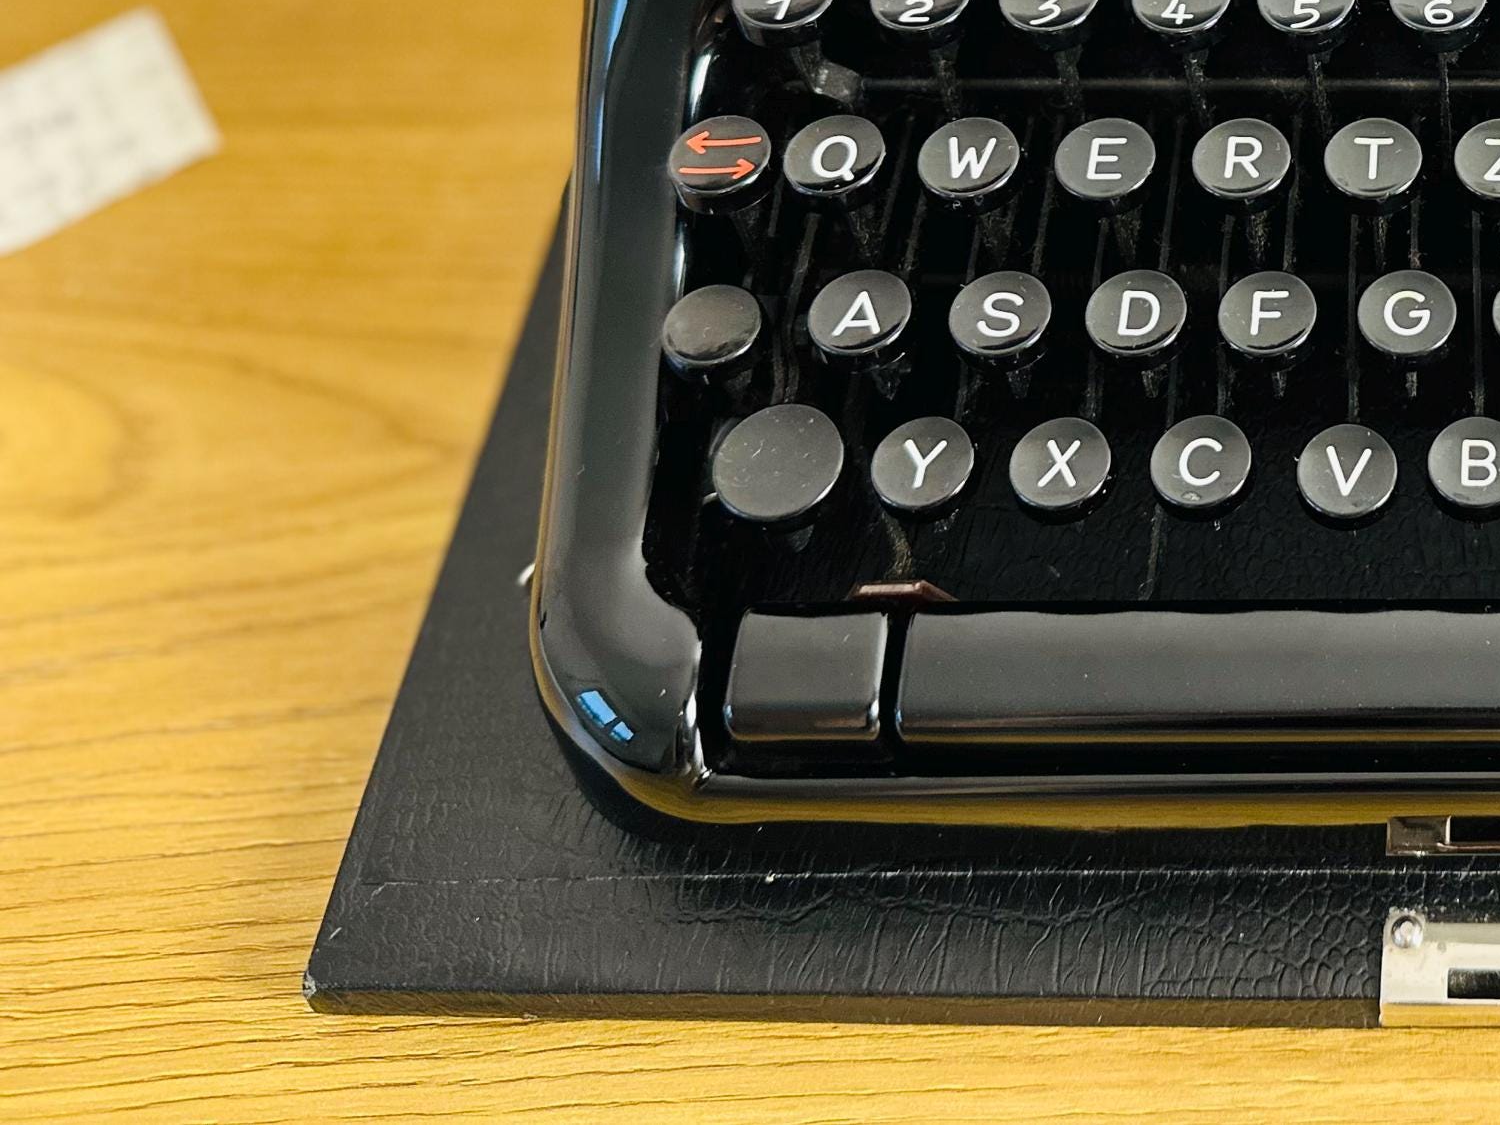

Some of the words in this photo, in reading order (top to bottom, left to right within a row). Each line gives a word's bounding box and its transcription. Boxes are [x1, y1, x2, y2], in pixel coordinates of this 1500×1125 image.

[811, 135, 858, 181] Q
[948, 136, 997, 180] W
[1086, 137, 1128, 180] E
[1223, 136, 1263, 179] R
[1353, 137, 1394, 180] T
[831, 290, 881, 337] A
[976, 292, 1024, 338] S
[1117, 290, 1161, 336] D
[1250, 290, 1290, 336] F
[1383, 290, 1431, 336] G
[903, 439, 948, 489] Y
[1037, 439, 1081, 488] X
[1178, 437, 1223, 486] C
[1326, 445, 1372, 497] V
[1460, 439, 1498, 487] B
